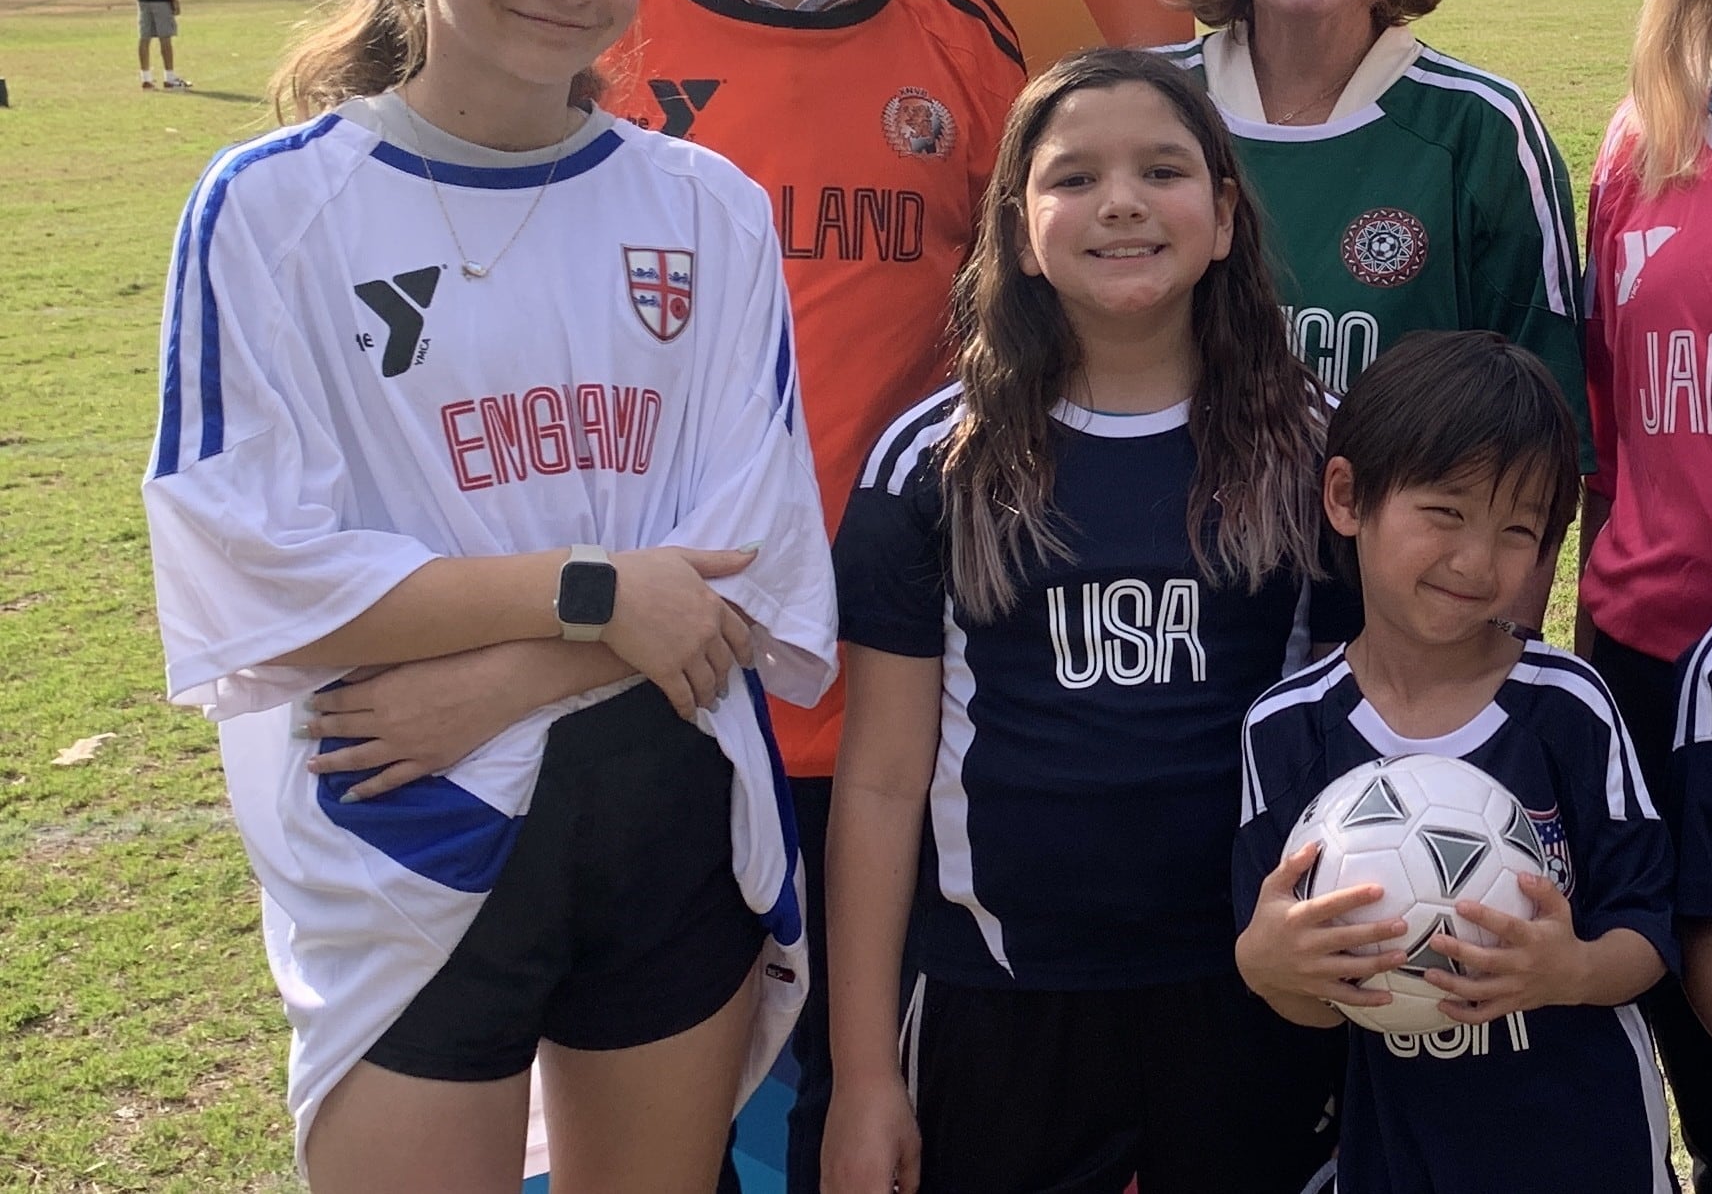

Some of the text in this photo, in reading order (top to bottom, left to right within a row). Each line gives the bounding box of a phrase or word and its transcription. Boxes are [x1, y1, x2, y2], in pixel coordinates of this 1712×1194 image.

[782, 185, 924, 262] LAND
[414, 338, 432, 366] YMCA
[441, 383, 662, 492] ENGLAND
[1046, 578, 1207, 690] USA
